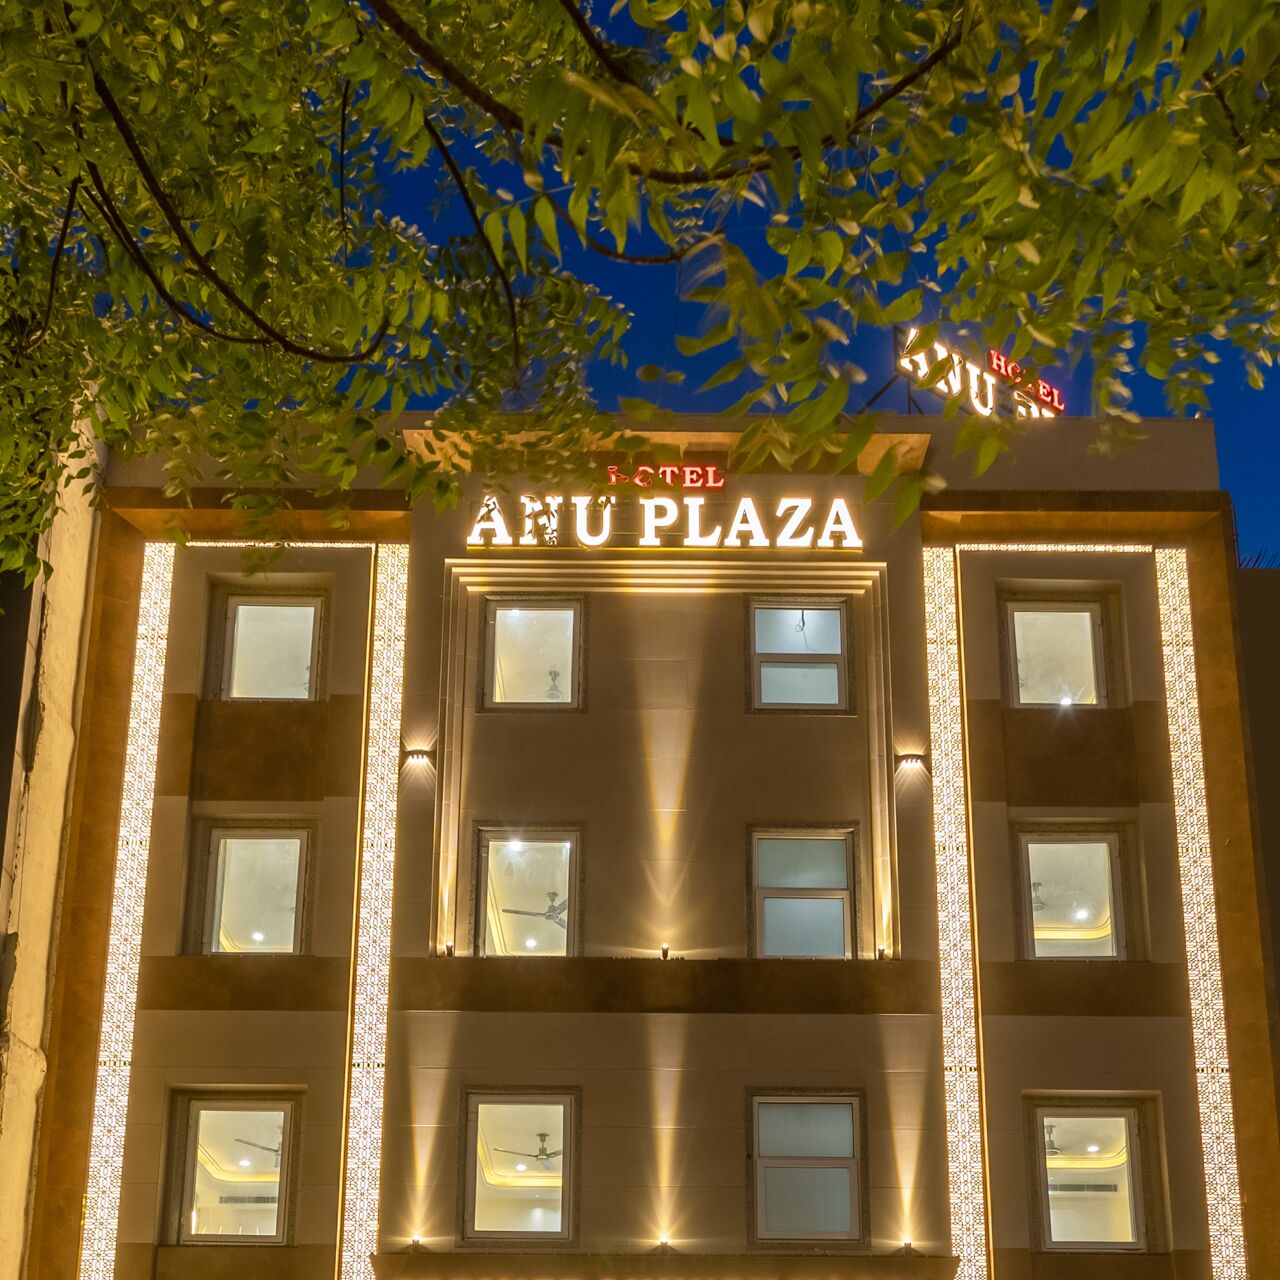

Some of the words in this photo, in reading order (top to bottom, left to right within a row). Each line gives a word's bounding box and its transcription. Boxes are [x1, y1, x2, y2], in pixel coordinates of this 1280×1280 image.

[989, 349, 1065, 411] HOEL
[466, 495, 616, 548] ANU
[638, 496, 864, 548] PLAZA
